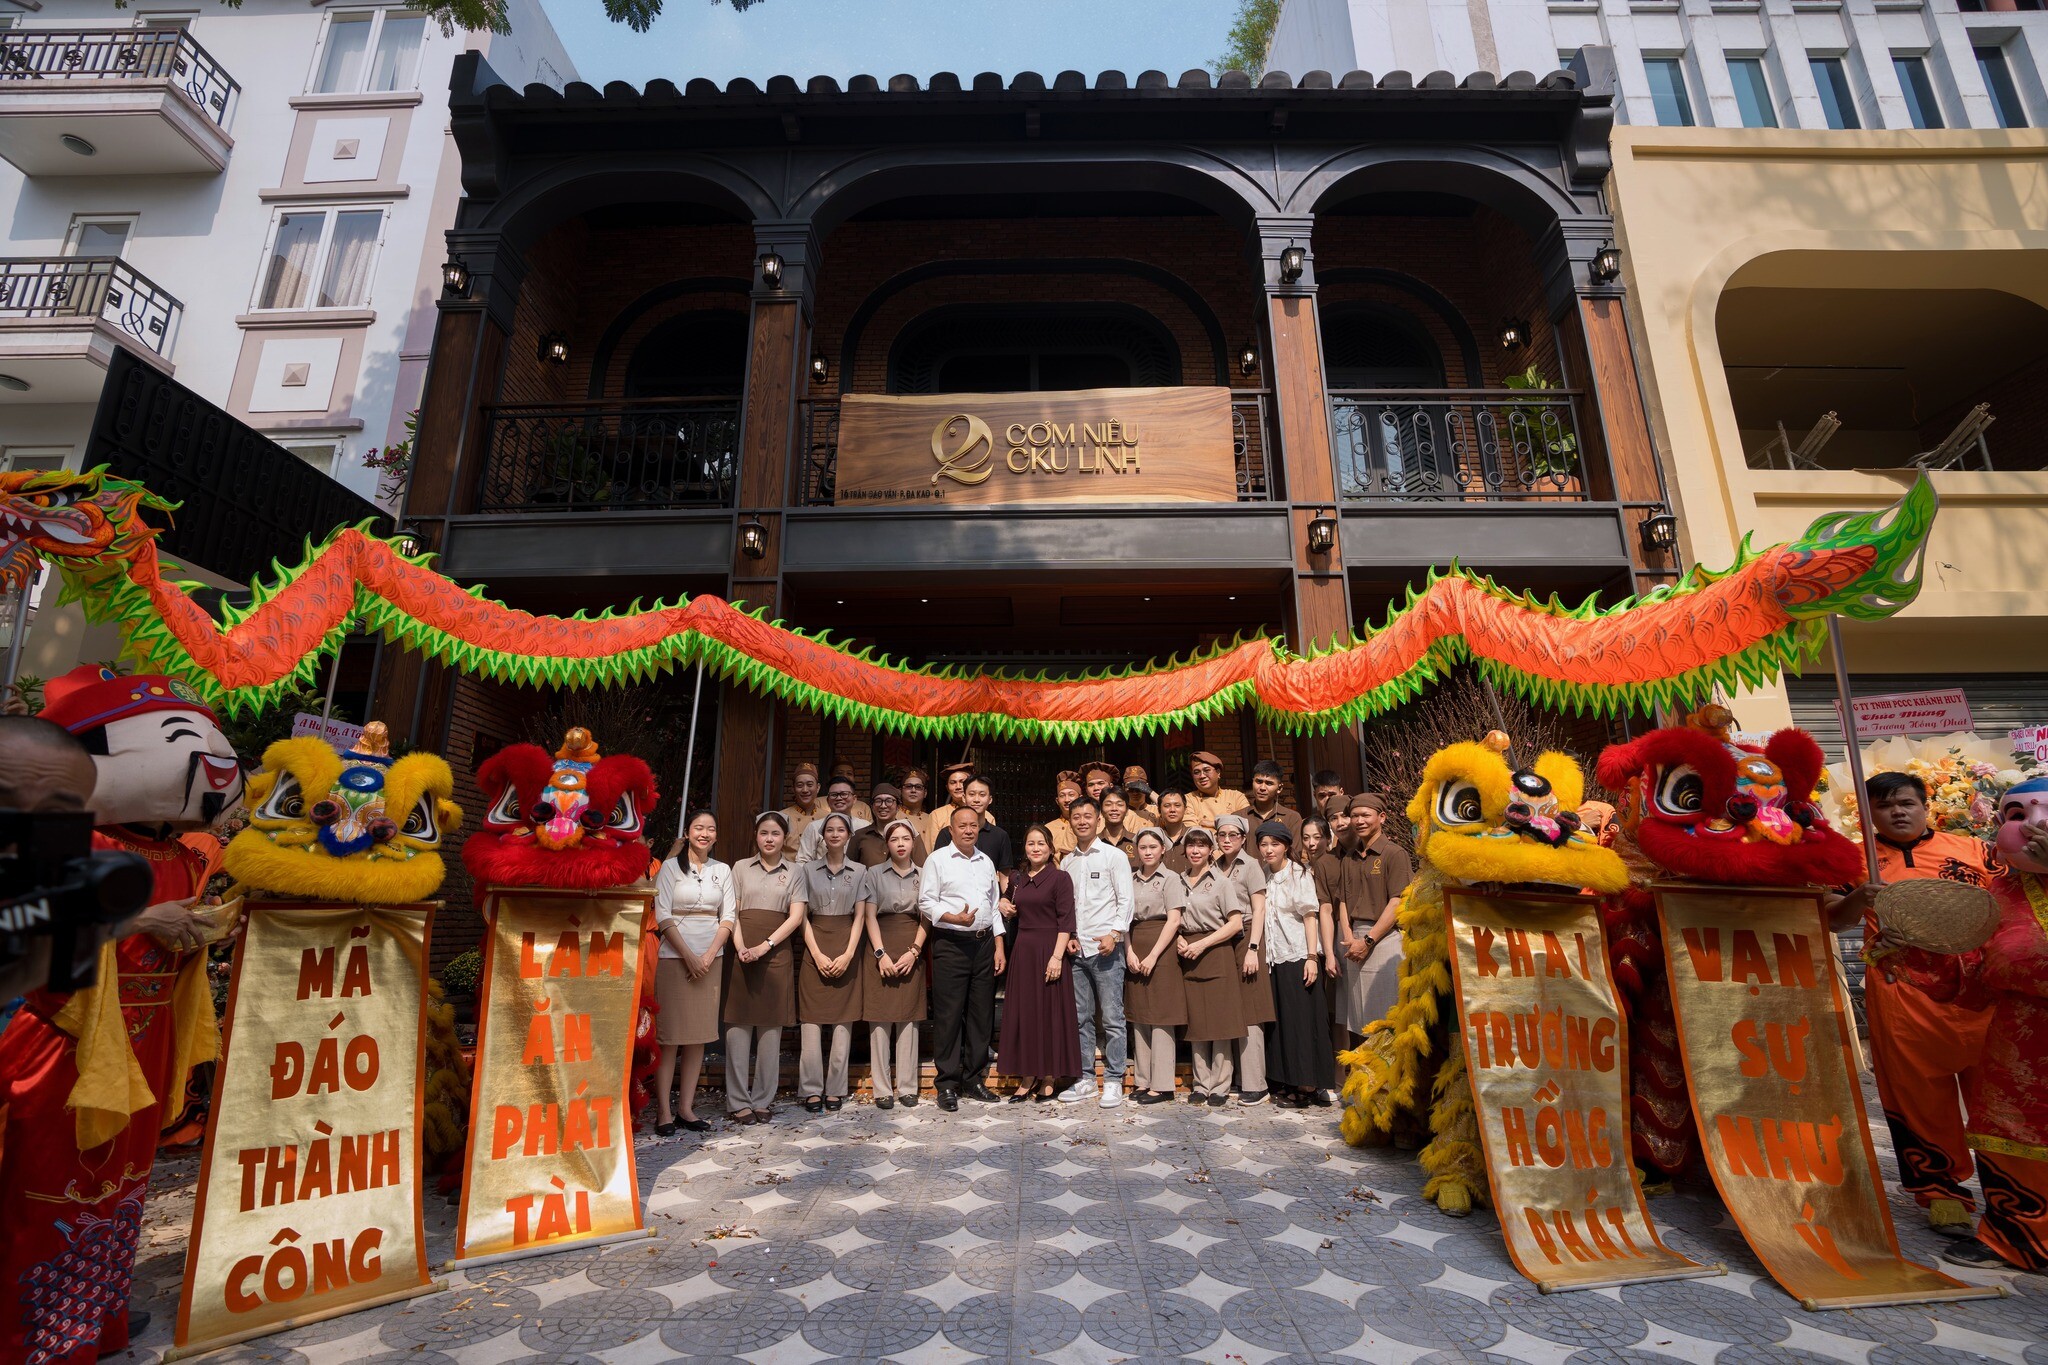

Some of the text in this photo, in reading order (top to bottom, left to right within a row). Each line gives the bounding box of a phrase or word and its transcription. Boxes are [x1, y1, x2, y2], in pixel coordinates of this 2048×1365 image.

[1006, 417, 1139, 447] CƠM NIÊU
[1006, 446, 1140, 474] CKU LINH
[1870, 700, 1892, 710] TNHH
[1892, 699, 1913, 708] PCCC
[1943, 694, 1962, 704] HUY
[297, 925, 372, 1000] MÃ
[520, 914, 624, 979] LÀM
[1472, 926, 1592, 981] KHAI
[1681, 927, 1817, 996] VẠN
[270, 1011, 380, 1100] ĐÁO
[522, 997, 592, 1065] ĂN
[1469, 1003, 1616, 1072] TRƯƠNG
[1731, 1016, 1810, 1095] SỰ
[491, 1080, 613, 1160] PHÁT
[1502, 1078, 1612, 1169] HỒNG
[1715, 1114, 1844, 1186] NHƯ
[238, 1119, 400, 1212] THÀNH
[506, 1174, 592, 1246] TÀI
[1523, 1185, 1648, 1265] PHÁT
[1793, 1201, 1868, 1280] Ý
[224, 1227, 383, 1314] CÔNG
